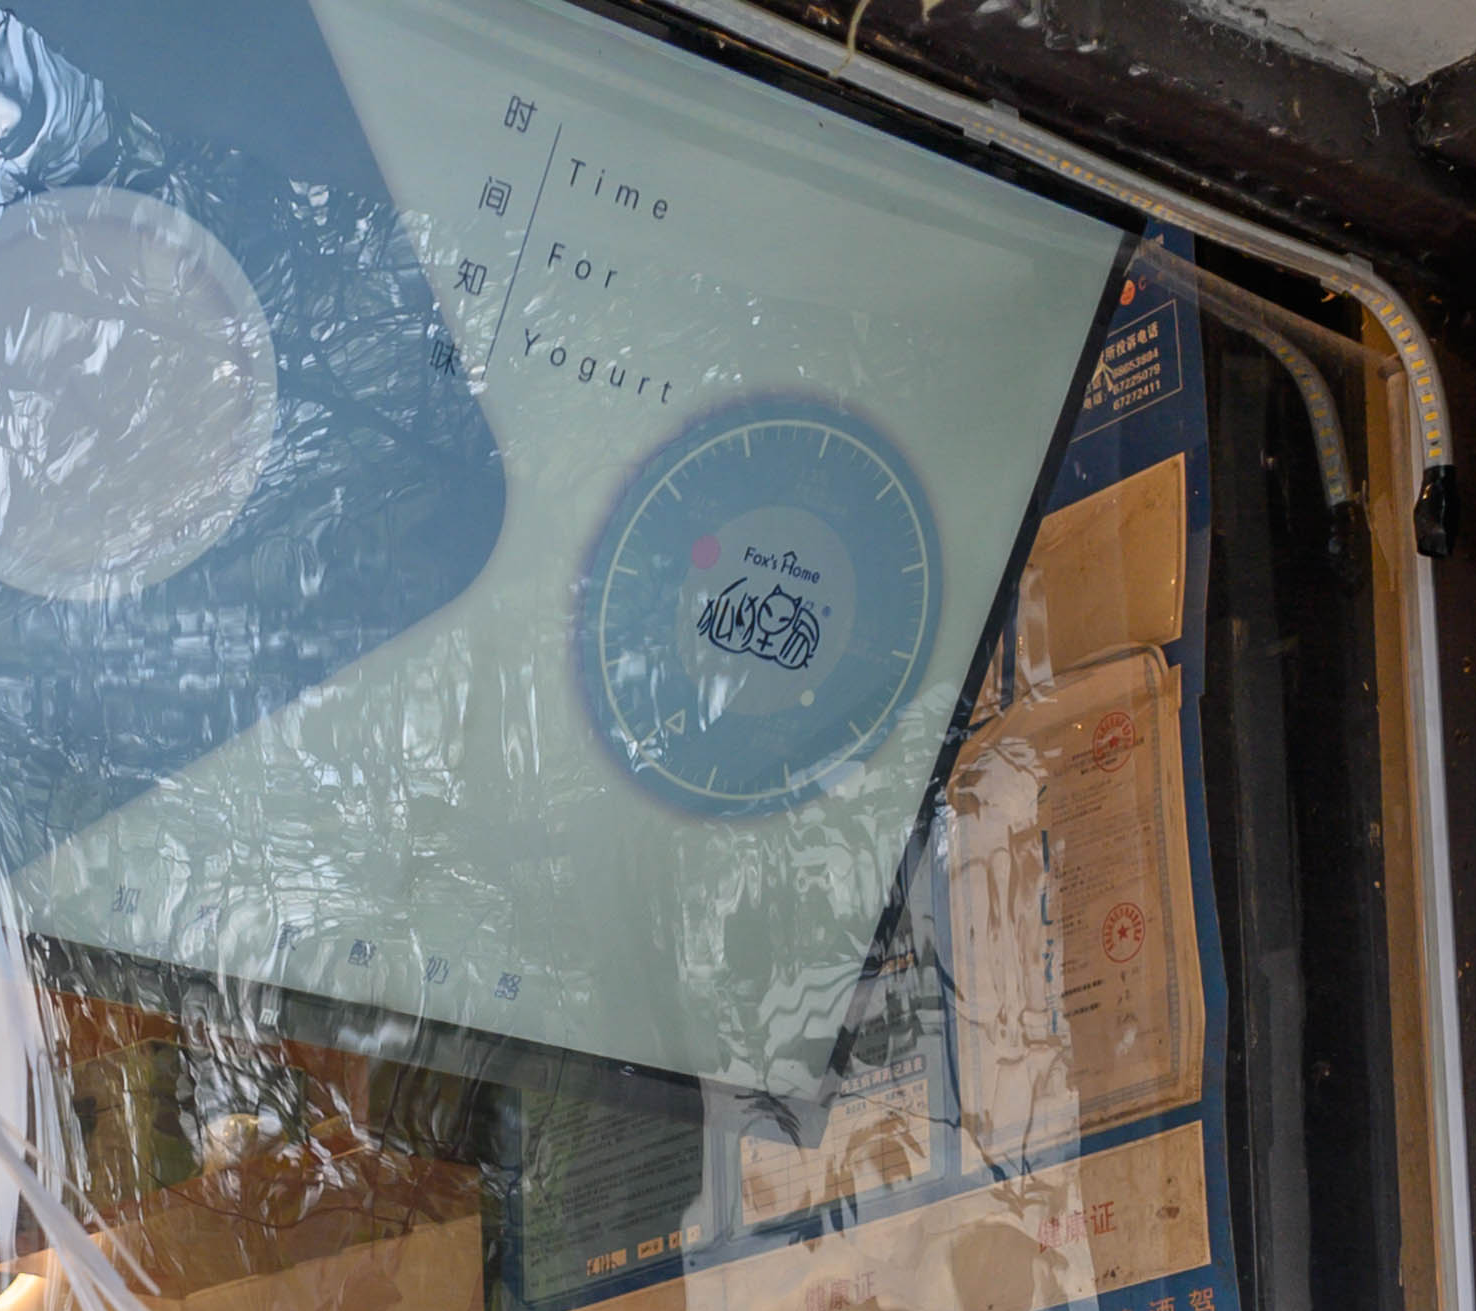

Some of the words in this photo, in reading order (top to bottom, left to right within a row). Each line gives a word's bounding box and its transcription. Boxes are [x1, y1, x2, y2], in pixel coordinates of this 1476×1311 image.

[569, 157, 668, 220] Time
[547, 242, 618, 288] For
[524, 328, 673, 405] Yogurt
